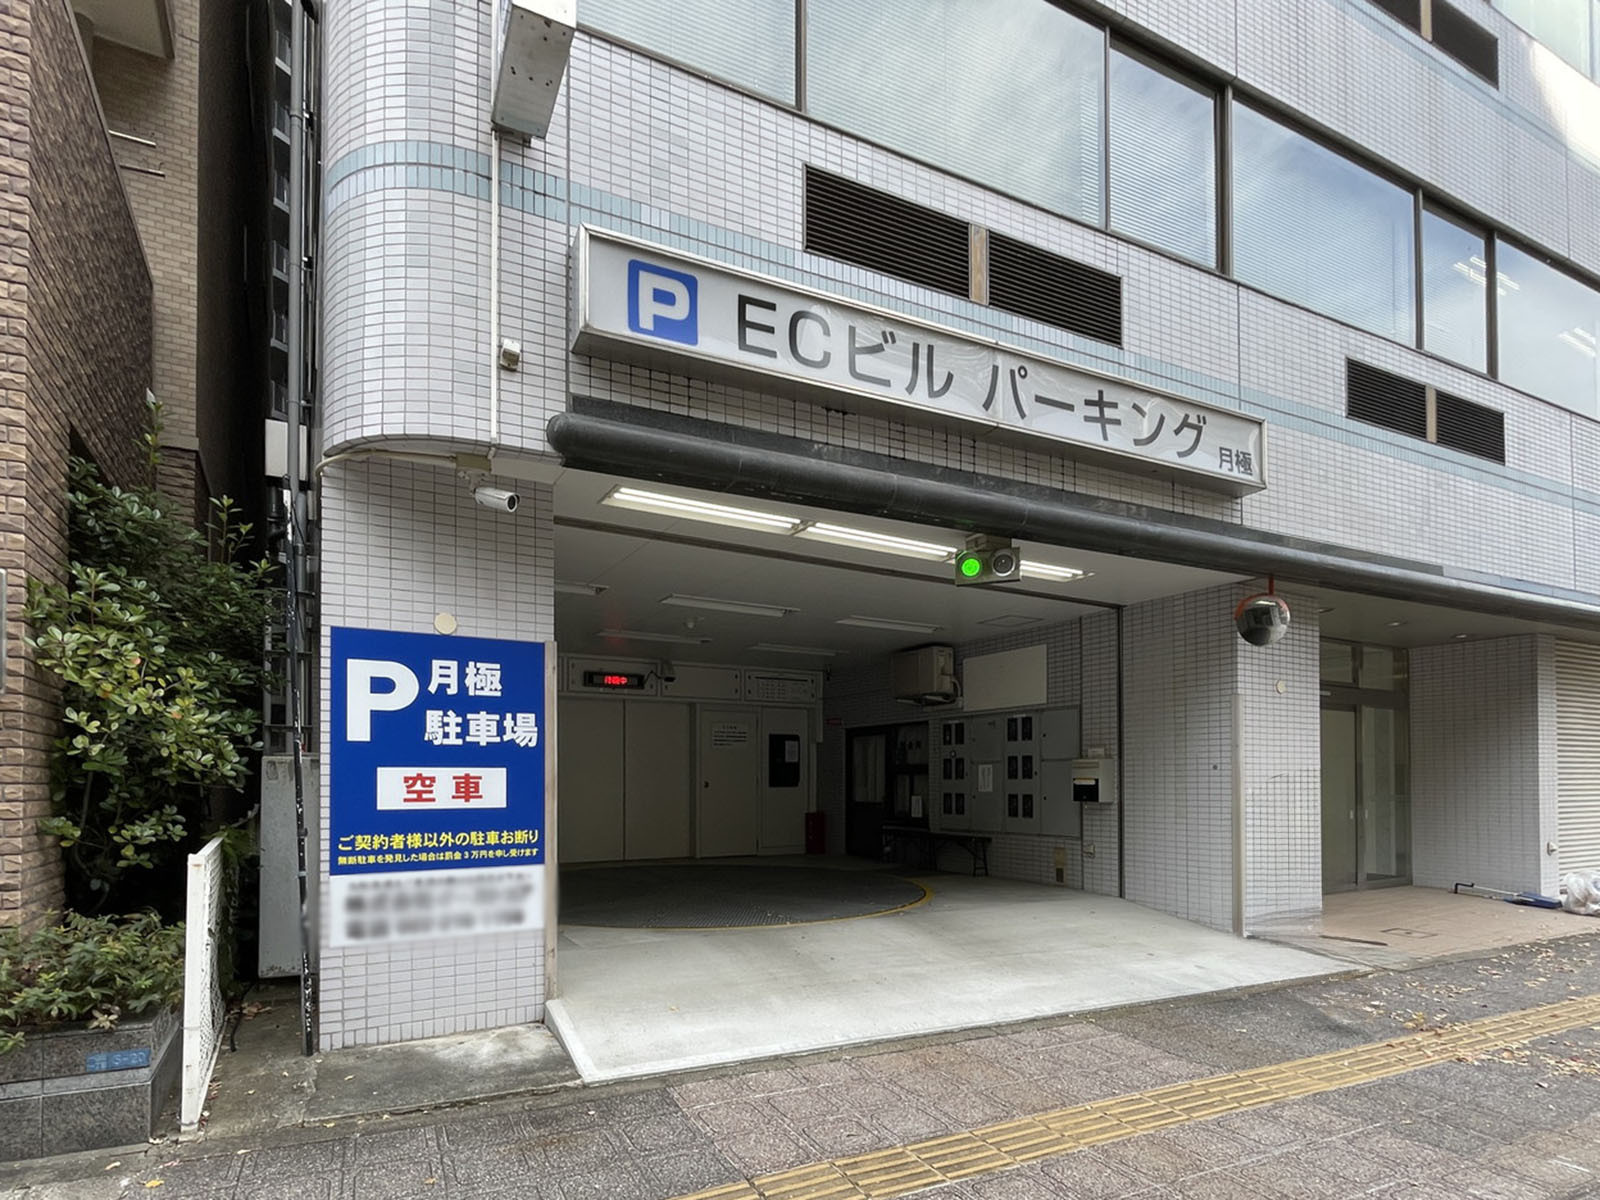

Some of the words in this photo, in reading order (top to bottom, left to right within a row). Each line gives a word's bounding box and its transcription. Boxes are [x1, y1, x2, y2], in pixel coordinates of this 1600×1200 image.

[638, 272, 691, 331] P
[738, 294, 954, 400] ECビル
[983, 364, 1207, 458] パーキング
[1218, 448, 1253, 475] 月極
[428, 659, 503, 697] 月極
[347, 658, 419, 742] P
[425, 710, 538, 747] 駐車場
[339, 829, 538, 851] ご契約者様以外の駐車お断り
